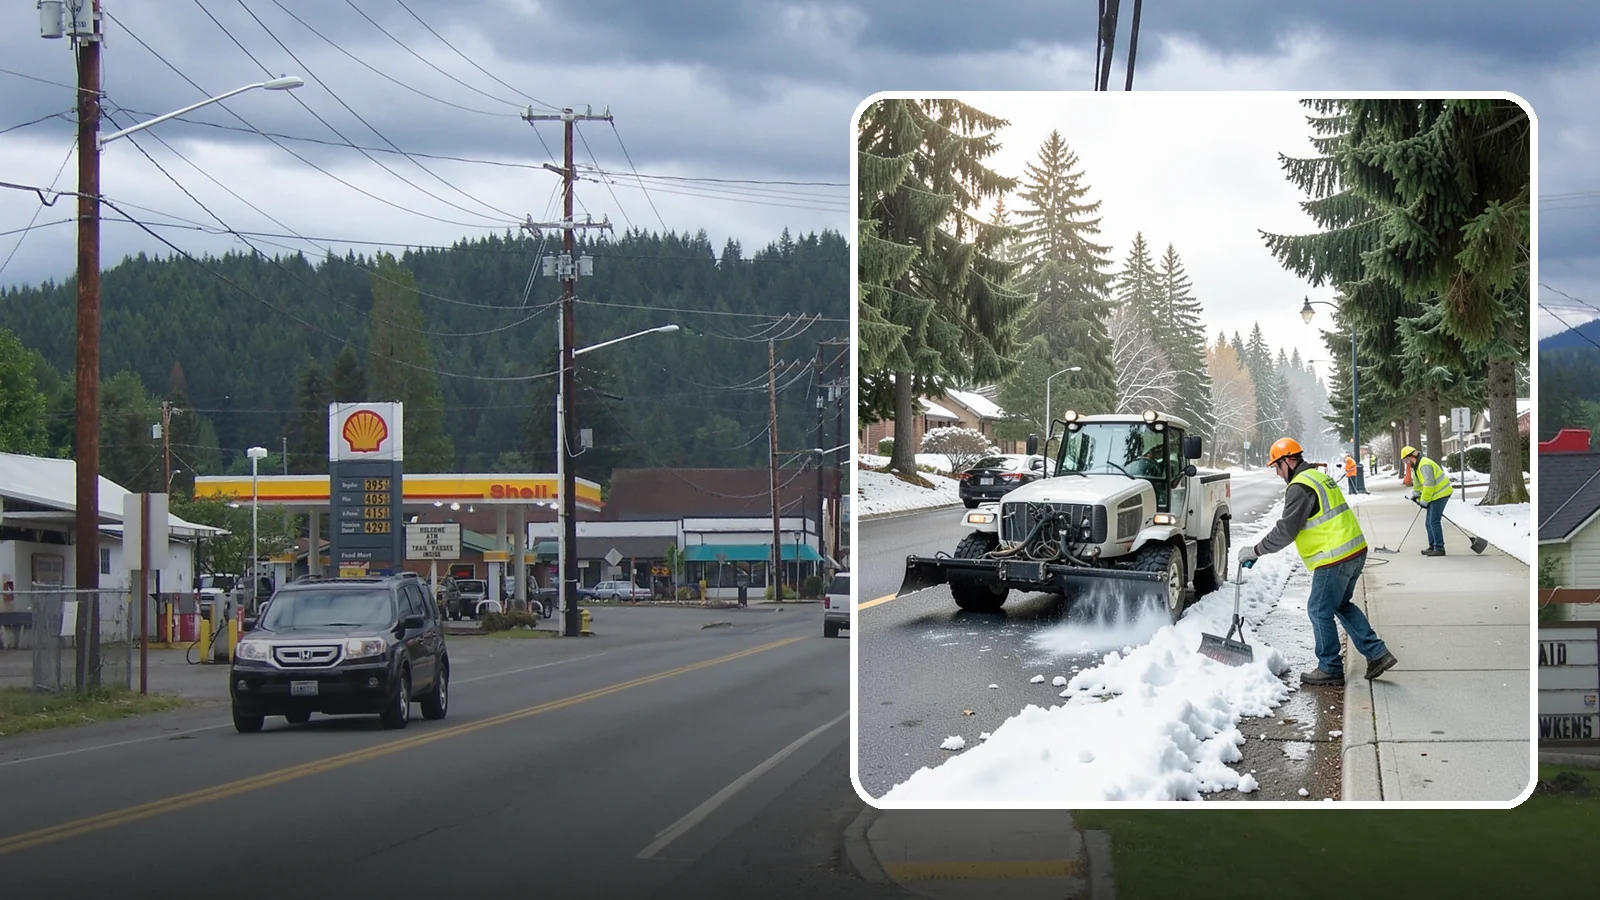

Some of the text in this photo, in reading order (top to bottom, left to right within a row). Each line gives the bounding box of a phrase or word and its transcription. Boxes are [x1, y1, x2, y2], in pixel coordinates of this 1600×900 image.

[366, 480, 383, 490] 395
[490, 484, 548, 499] Shell
[365, 494, 383, 504] 405
[365, 508, 383, 518] 415
[365, 522, 383, 532] 429
